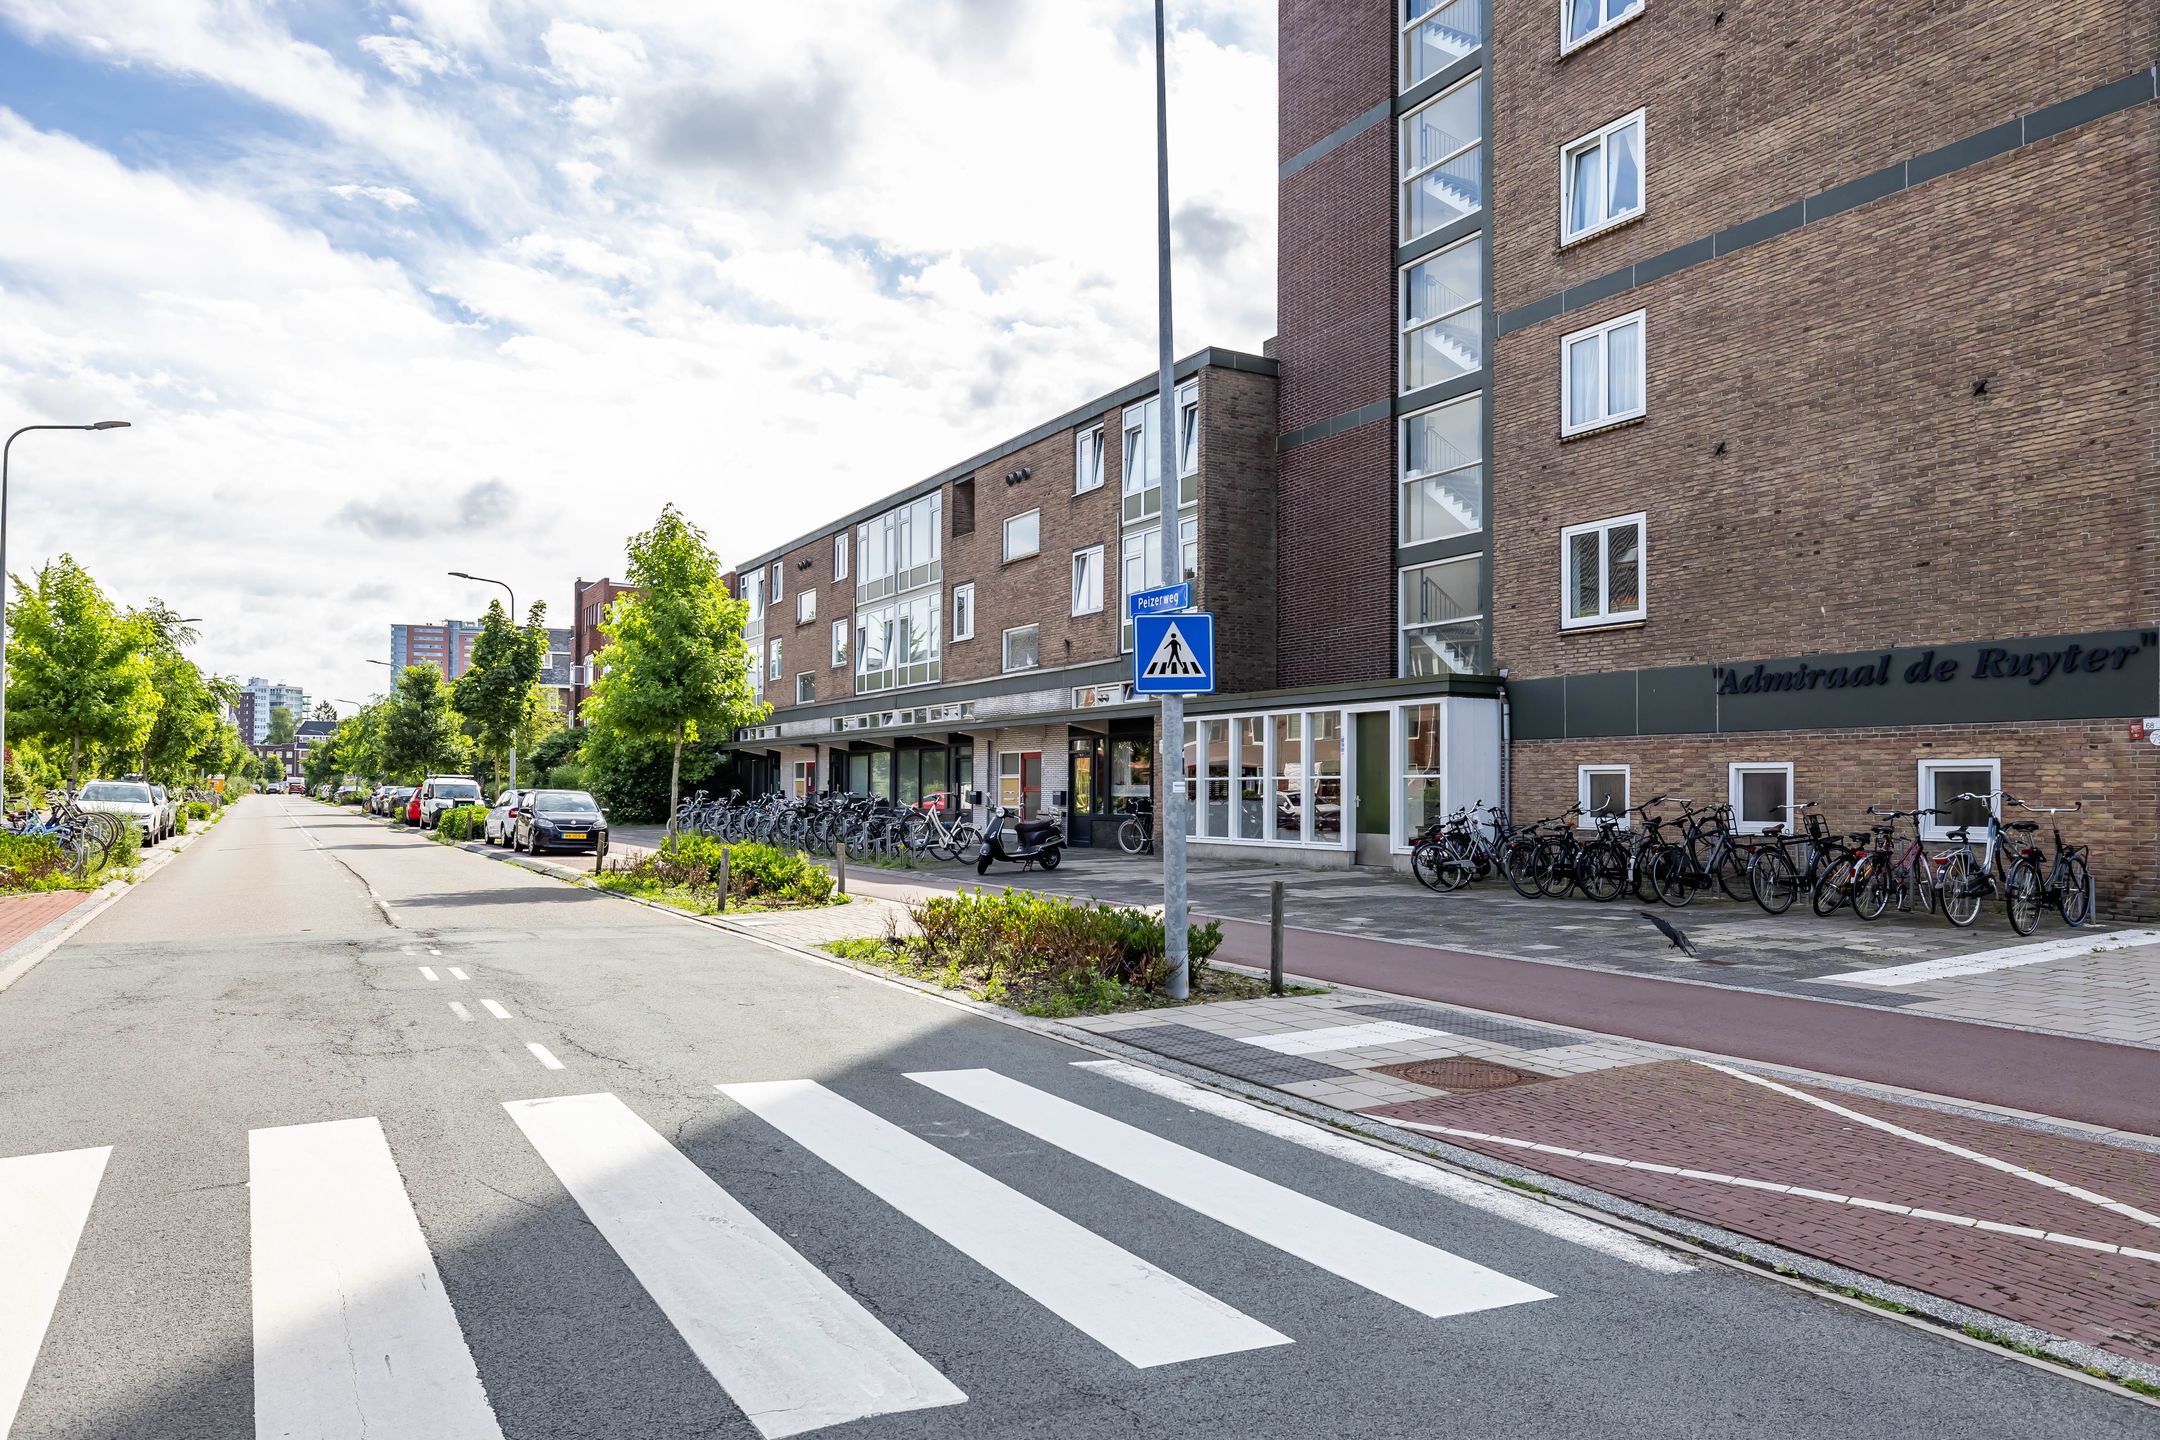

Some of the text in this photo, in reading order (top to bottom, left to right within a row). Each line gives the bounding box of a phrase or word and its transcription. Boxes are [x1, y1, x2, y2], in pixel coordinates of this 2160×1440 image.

[1138, 592, 1179, 609] Peizerweg
[1712, 631, 2157, 695] "Admiraal de Ruyter"
